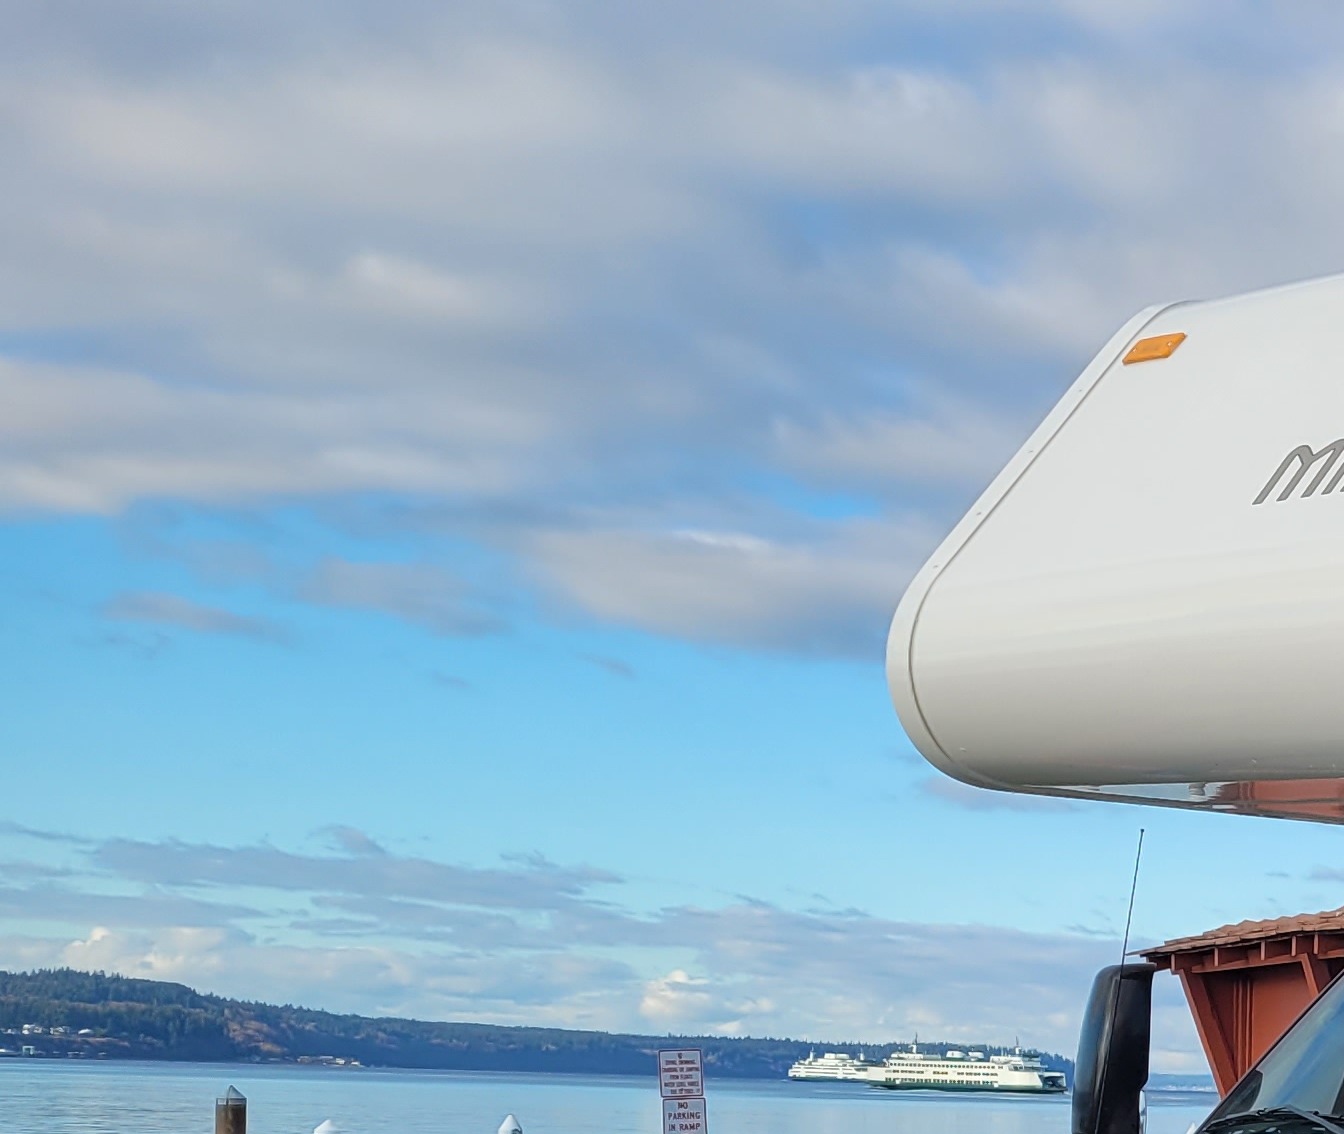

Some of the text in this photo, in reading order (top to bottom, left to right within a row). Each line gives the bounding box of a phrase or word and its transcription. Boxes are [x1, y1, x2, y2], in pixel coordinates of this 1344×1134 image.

[677, 1101, 689, 1110] NO
[668, 1111, 701, 1120] PARKING
[668, 1122, 701, 1131] IN RAMP
